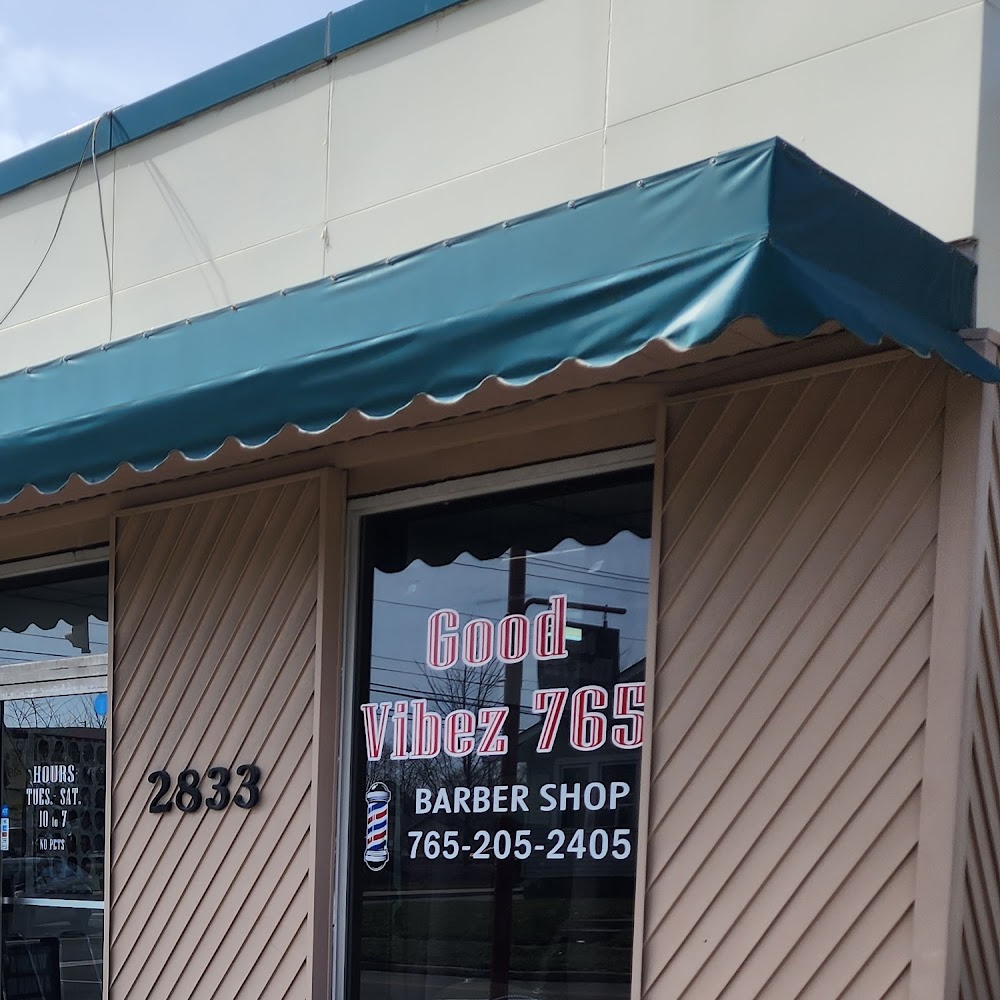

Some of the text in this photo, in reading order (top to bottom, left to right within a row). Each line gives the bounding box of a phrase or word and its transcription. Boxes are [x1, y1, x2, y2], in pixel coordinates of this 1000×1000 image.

[426, 594, 568, 671] Good
[361, 682, 646, 762] Vibez 765
[33, 765, 75, 783] HOURS
[148, 764, 261, 813] 2833
[415, 782, 631, 815] BARBER SHOP
[39, 810, 67, 828] 10 to 7
[40, 838, 65, 850] NO PETS
[408, 829, 631, 860] 765-205-2405
